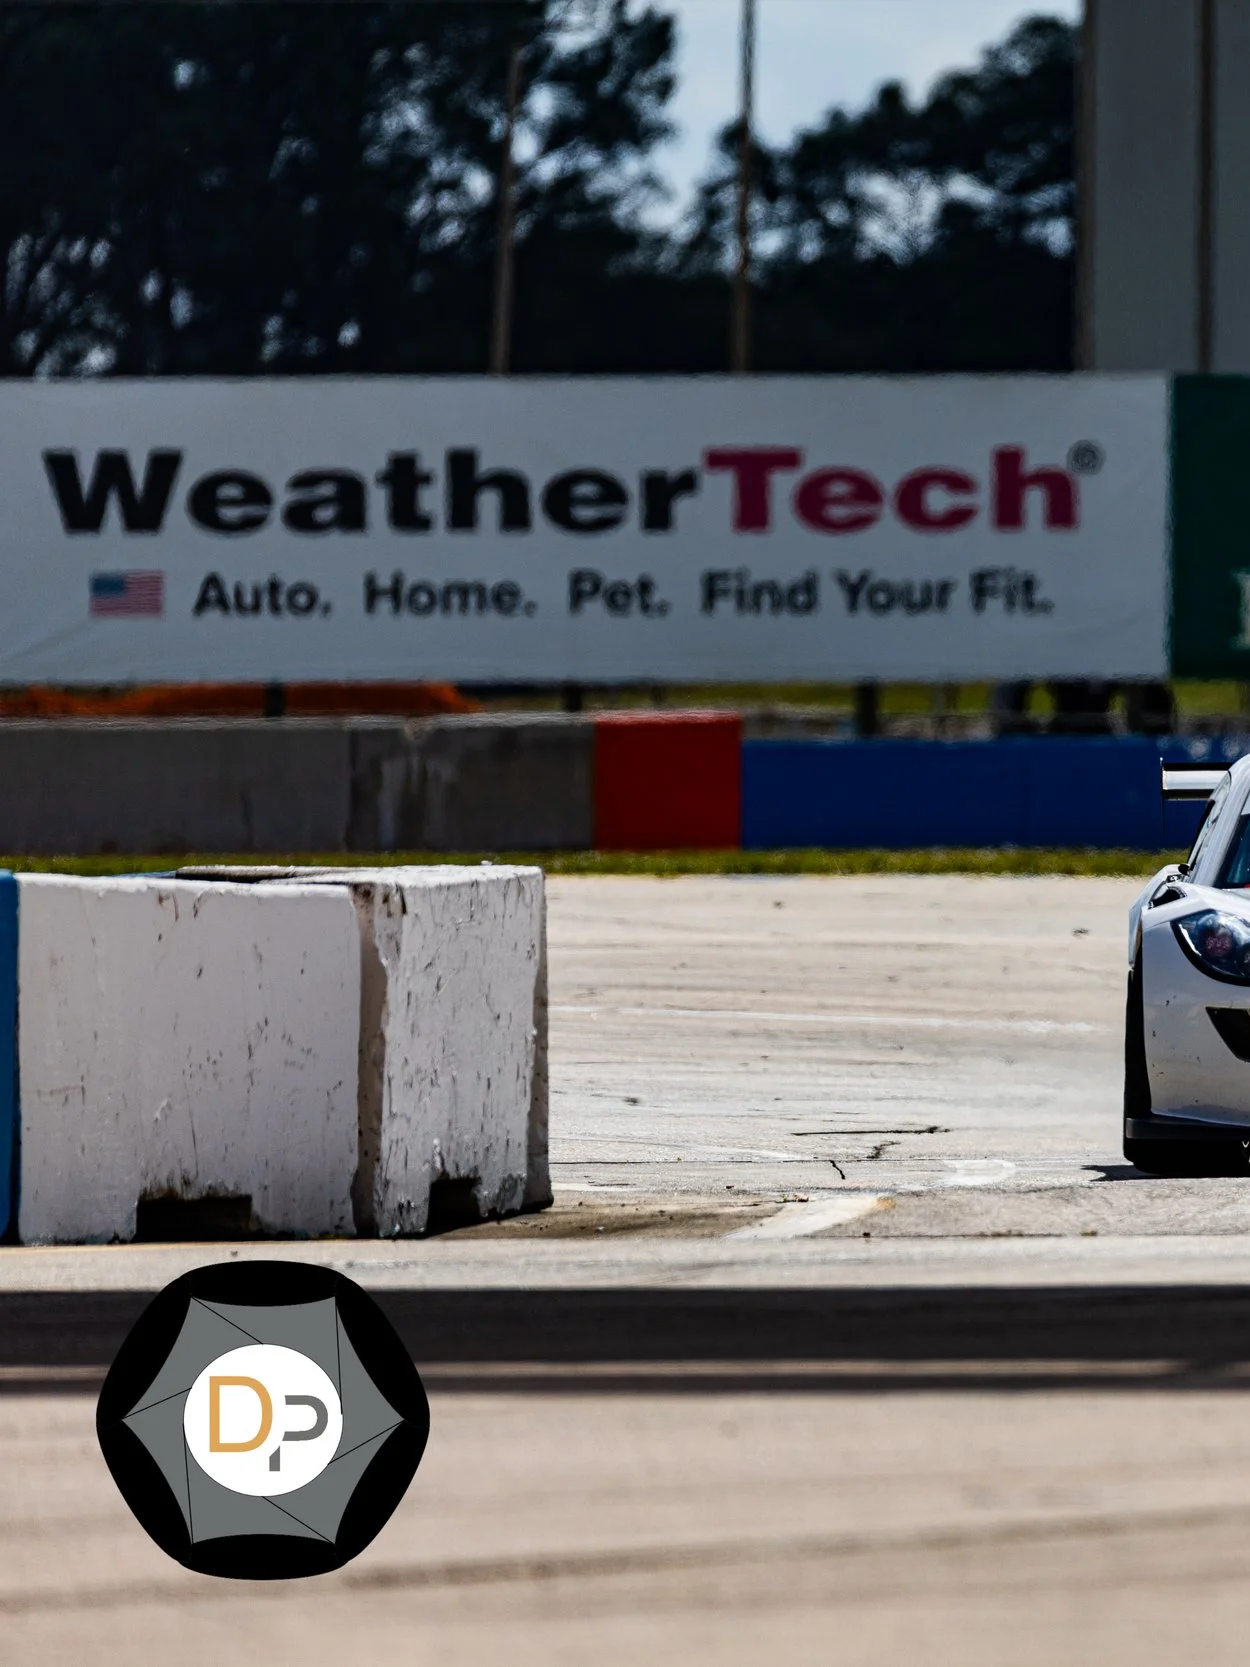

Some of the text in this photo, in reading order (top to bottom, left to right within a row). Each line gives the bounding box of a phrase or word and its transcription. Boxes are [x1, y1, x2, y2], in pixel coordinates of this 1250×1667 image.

[363, 570, 537, 616] Home.
[568, 568, 670, 615] Pet.
[701, 566, 818, 615] Find
[835, 567, 954, 615] Your
[971, 566, 1054, 614] Fit.
